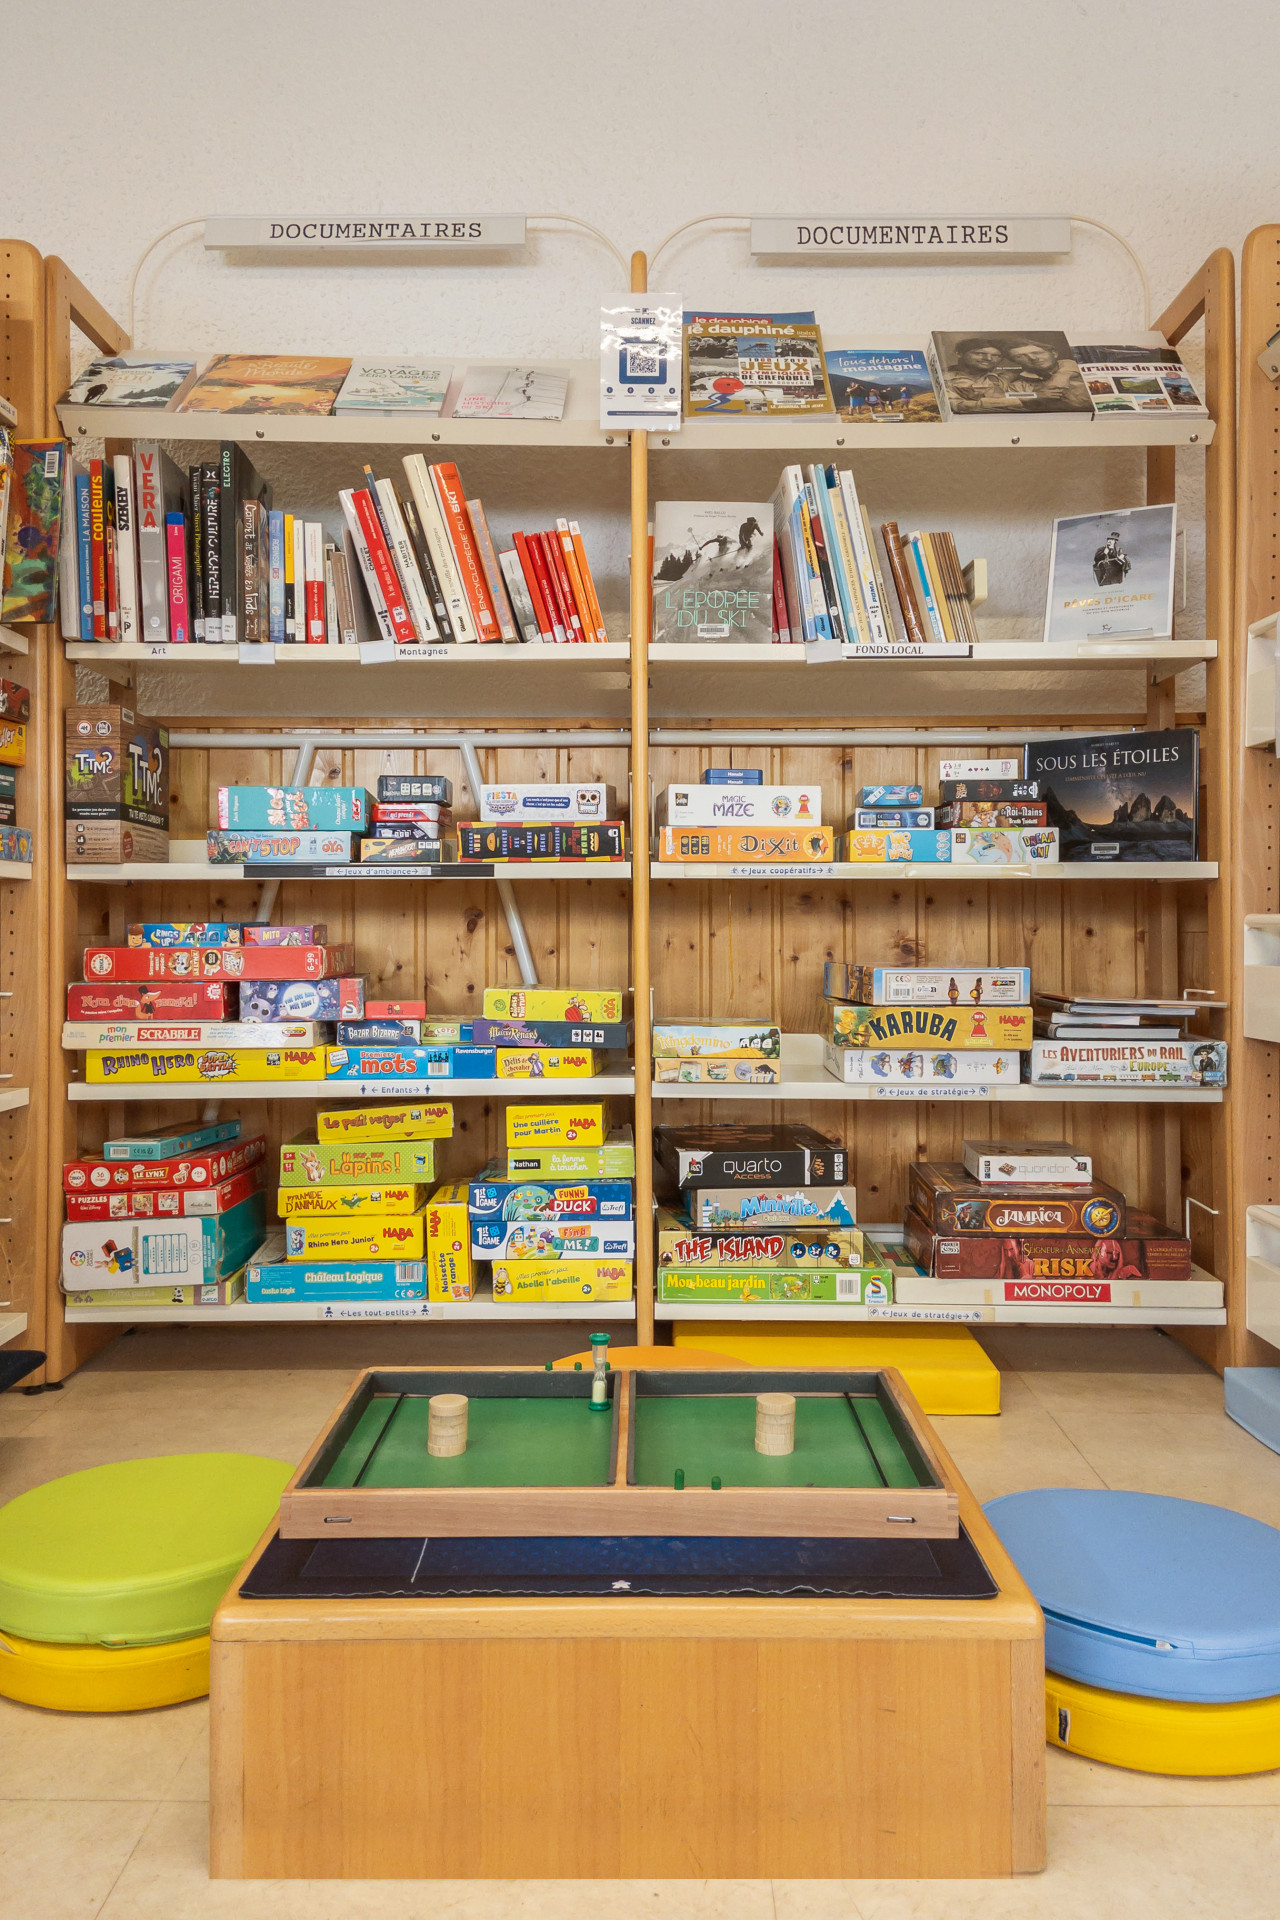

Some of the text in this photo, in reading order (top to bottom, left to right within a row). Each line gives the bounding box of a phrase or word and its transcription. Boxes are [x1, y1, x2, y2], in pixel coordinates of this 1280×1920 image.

[270, 223, 482, 239] DOCUMENTAIRES
[797, 225, 1009, 244] DOCUMENTAIRES
[631, 317, 656, 325] SCANNEZ
[361, 367, 441, 376] VOYAGES
[741, 361, 810, 371] JEUX
[842, 363, 922, 373] montagne
[140, 453, 156, 528] VERA
[80, 488, 90, 541] LA MAISON
[91, 475, 103, 541] couleurs
[207, 499, 218, 547] CULTURE
[398, 541, 411, 568] HABITER
[448, 491, 487, 609] ENCYCLOPÉDIE DU SKI
[363, 546, 376, 571] CHALET
[172, 556, 184, 604] ORIGAMI
[1063, 598, 1101, 609] RÊVES
[1104, 592, 1154, 604] D'ICARE
[718, 609, 748, 627] SKI
[399, 648, 449, 657] Montagnes
[855, 646, 924, 655] FONDS LOCAL
[1036, 746, 1180, 772] SOUS LES ÉTOILES
[486, 791, 517, 800] FIESTA
[722, 795, 747, 803] MAGIC
[713, 803, 754, 817] MAZE
[1022, 831, 1057, 846] DREAM
[228, 837, 300, 856] CAN'T STOP
[322, 841, 344, 852] OYA
[1030, 845, 1049, 859] ON!
[345, 866, 411, 876] Jeux d'ambiance
[769, 866, 817, 876] coopératifs
[155, 929, 179, 939] RINGS
[262, 930, 281, 940] MITO
[161, 937, 175, 947] UP!
[306, 952, 315, 972] 6-99
[81, 995, 110, 1008] Nom
[604, 998, 616, 1019] OYA
[868, 1011, 958, 1042] KARUBA
[999, 1015, 1026, 1027] HABA
[107, 1026, 127, 1034] mon
[139, 1029, 199, 1039] SCRABBLE
[348, 1025, 400, 1040] BAZAR BIZARRE
[436, 1027, 456, 1035] LOTO
[99, 1034, 135, 1043] premier
[659, 1032, 731, 1049] Kingdomino
[202, 1055, 228, 1063] SUPER
[285, 1051, 317, 1065] HABA
[1043, 1046, 1187, 1061] LES AVENTURIERS DU RAIL
[102, 1053, 195, 1076] RHINO HERO
[200, 1061, 233, 1071] BATTLE
[360, 1054, 417, 1074] mots
[563, 1056, 588, 1067] HABA
[1130, 1060, 1170, 1072] EUROPE
[382, 1086, 413, 1094] Enfants
[896, 1088, 915, 1096] Jeux
[931, 1087, 969, 1096] stratégie
[425, 1107, 448, 1117] HABA
[324, 1112, 407, 1130] Le petit verger
[513, 1118, 559, 1129] Une cuillère
[569, 1117, 596, 1130] HABA
[514, 1126, 561, 1138] pour Martin
[330, 1153, 392, 1177] Lapins
[514, 1160, 538, 1168] Nathan
[552, 1154, 585, 1165] la ferme
[557, 1161, 588, 1171] toucher
[145, 1170, 165, 1178] LYNX
[77, 1196, 107, 1204] PUZZLES
[286, 1190, 322, 1201] PYRAMIDE
[385, 1190, 409, 1200] HABA
[558, 1189, 585, 1200] FUNNY
[286, 1200, 337, 1213] D'ANIMAUX
[480, 1198, 497, 1207] GAME
[554, 1200, 591, 1212] DUCK
[609, 1203, 624, 1212] Trefl
[740, 1195, 819, 1218] Minivilles
[430, 1210, 441, 1237] HABA
[383, 1227, 414, 1241] HABA
[483, 1236, 500, 1245] GAME
[308, 1235, 375, 1249] Rhino Hero Junior
[564, 1238, 591, 1251] ME!
[611, 1241, 628, 1250] Trefl
[674, 1235, 785, 1262] THE ISLAND
[441, 1252, 450, 1293] Noisette
[597, 1266, 626, 1280] HABA
[1032, 1257, 1094, 1277] RISK
[305, 1271, 383, 1285] Château Logique
[517, 1275, 581, 1289] Abella l'abeille
[666, 1274, 766, 1291] Mon beau jardin
[1014, 1284, 1102, 1299] MONOPOLY
[347, 1308, 410, 1317] Les tout-petits
[889, 1310, 963, 1320] Jeux de stratégie
